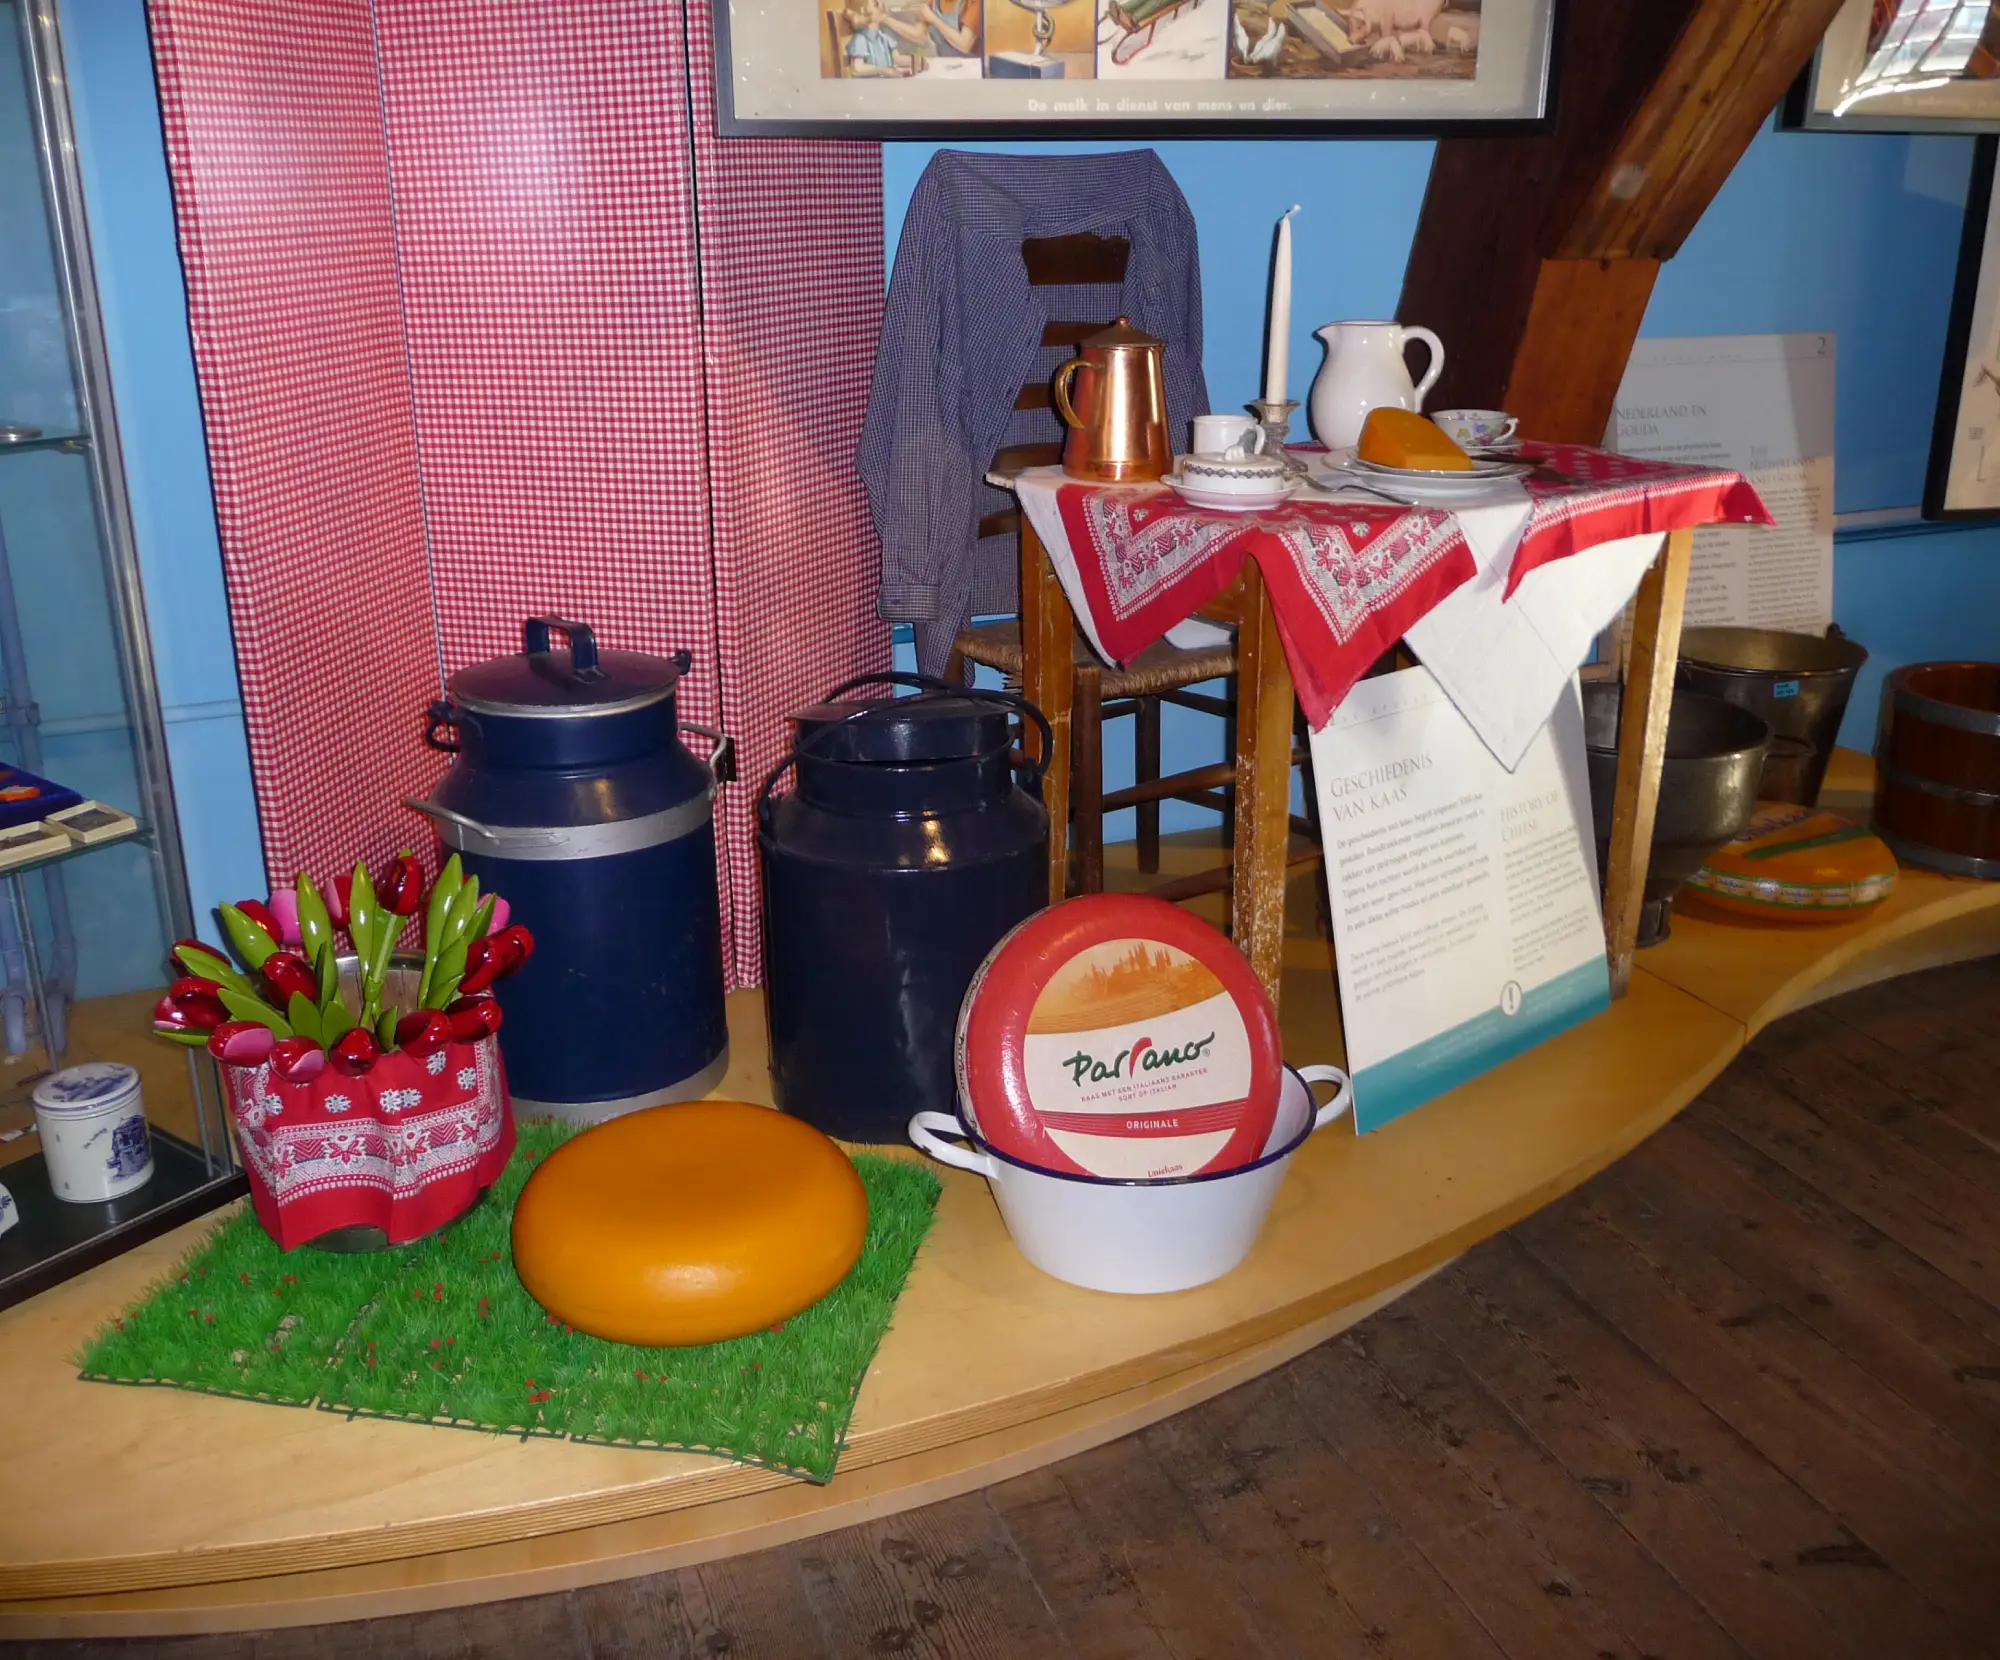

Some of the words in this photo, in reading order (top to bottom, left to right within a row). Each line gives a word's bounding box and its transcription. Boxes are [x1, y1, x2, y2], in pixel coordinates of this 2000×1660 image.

[1028, 98, 1048, 112] De
[1053, 98, 1089, 112] melk
[1096, 98, 1110, 112] in
[1116, 98, 1158, 112] dienst
[1164, 100, 1191, 112] van
[1198, 100, 1233, 112] mens
[1239, 100, 1256, 112] en
[1262, 98, 1292, 112] dier.
[1816, 336, 1826, 355] 2
[1616, 404, 1688, 420] NEDERLAND
[1692, 403, 1707, 417] EN
[1330, 754, 1433, 798] GESCHIEDENIS
[1333, 799, 1365, 822] VAN
[1369, 785, 1408, 811] KAAS
[1062, 1031, 1216, 1088] Parrano
[1080, 1092, 1100, 1103] KAAS
[1101, 1089, 1117, 1098] MET
[1117, 1085, 1132, 1095] EEN
[1133, 1076, 1170, 1091] ITALIAANS
[1171, 1067, 1209, 1082] KARAKTER
[1118, 1092, 1137, 1102] SORT
[1138, 1089, 1148, 1098] OF
[1149, 1083, 1178, 1096] ITALIAN
[1126, 1118, 1179, 1130] ORIGINALE
[1147, 1163, 1183, 1178] Uniekaas
